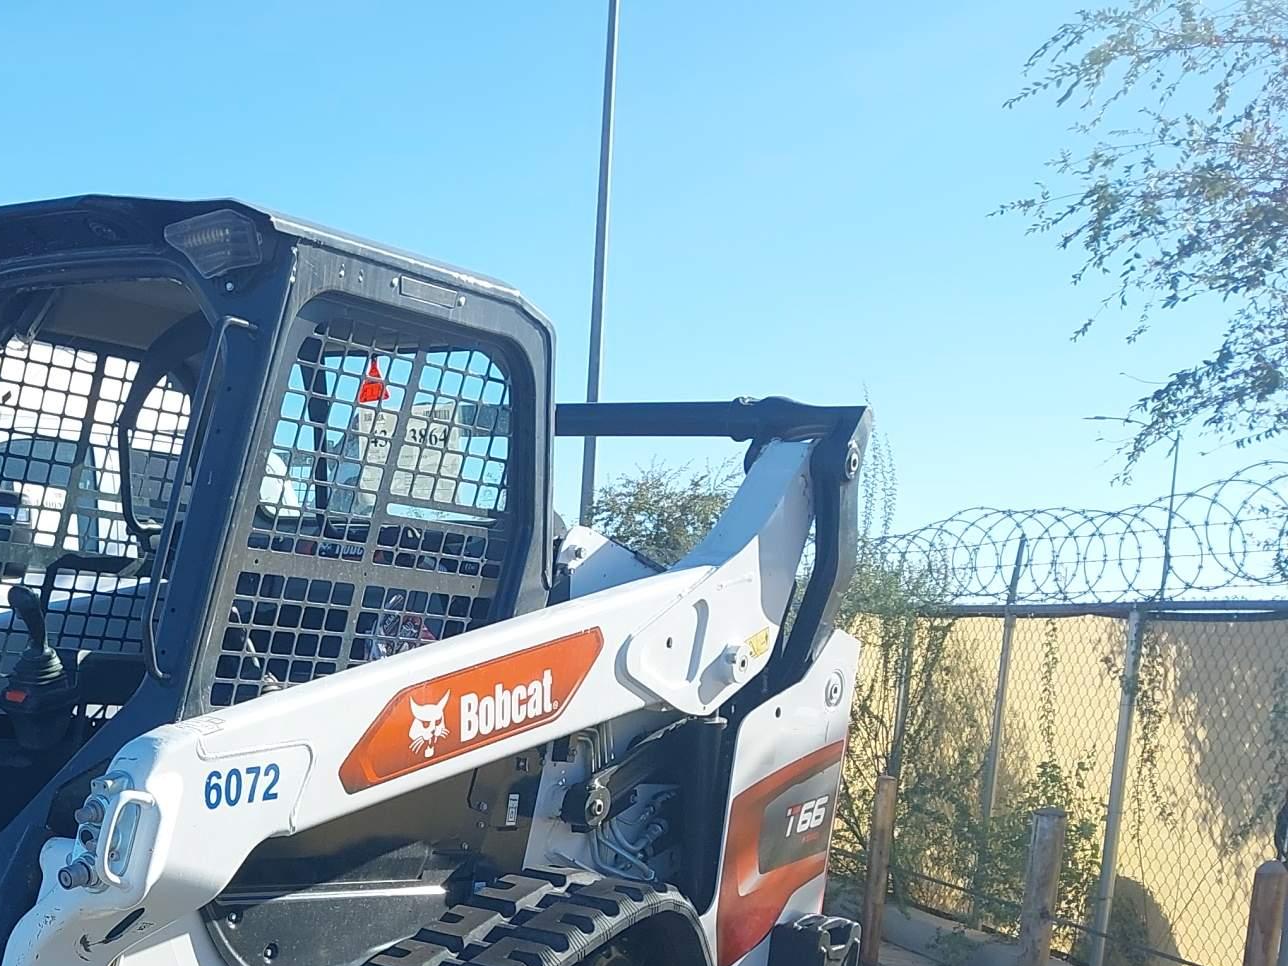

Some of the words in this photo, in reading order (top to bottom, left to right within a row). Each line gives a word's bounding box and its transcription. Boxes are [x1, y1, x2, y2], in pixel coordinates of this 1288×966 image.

[370, 427, 448, 448] 433864
[460, 668, 553, 743] Bobcat
[204, 762, 281, 810] 6072
[785, 795, 829, 838] T66
